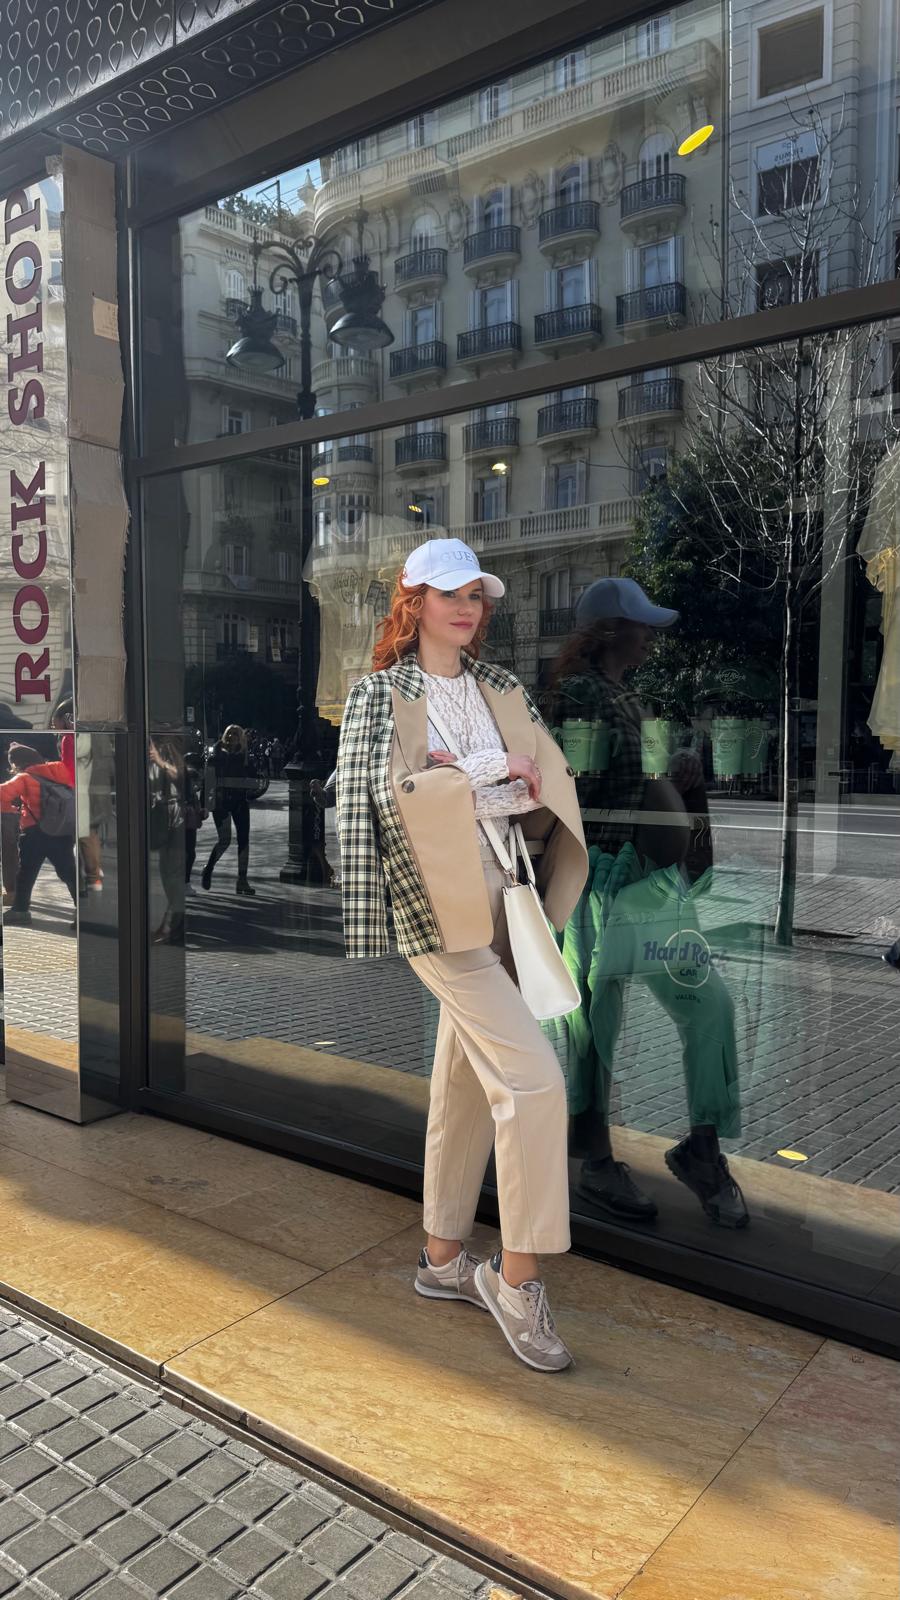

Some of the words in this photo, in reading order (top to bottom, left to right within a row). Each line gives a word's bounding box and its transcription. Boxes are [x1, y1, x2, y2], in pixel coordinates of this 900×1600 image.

[5, 188, 45, 425] SHOP
[10, 461, 51, 702] ROCK
[440, 551, 476, 562] GUE
[643, 941, 690, 961] Hard
